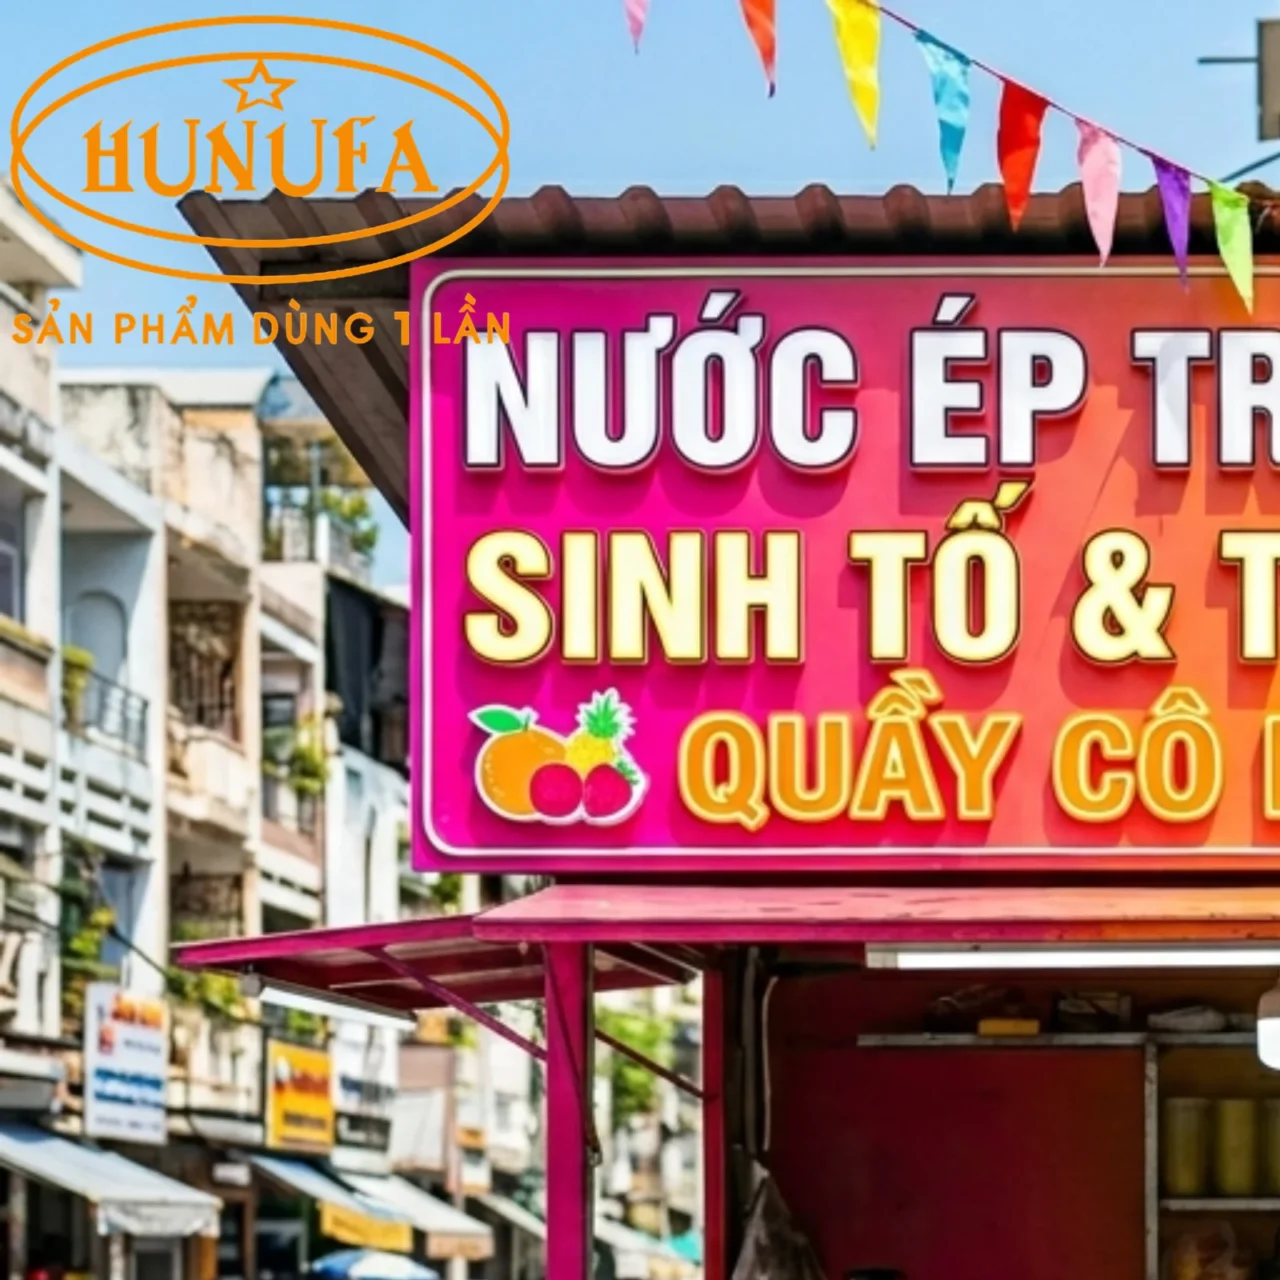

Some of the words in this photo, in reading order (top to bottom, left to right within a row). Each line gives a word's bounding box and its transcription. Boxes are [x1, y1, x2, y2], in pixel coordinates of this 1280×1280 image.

[463, 290, 859, 471] NƯỚC
[909, 294, 1088, 469] ÉP
[463, 529, 803, 664] SINH
[848, 482, 1033, 664] TỐ
[1071, 529, 1175, 664] &
[677, 668, 1022, 832] QUẦY
[1053, 685, 1223, 823] CÔ
